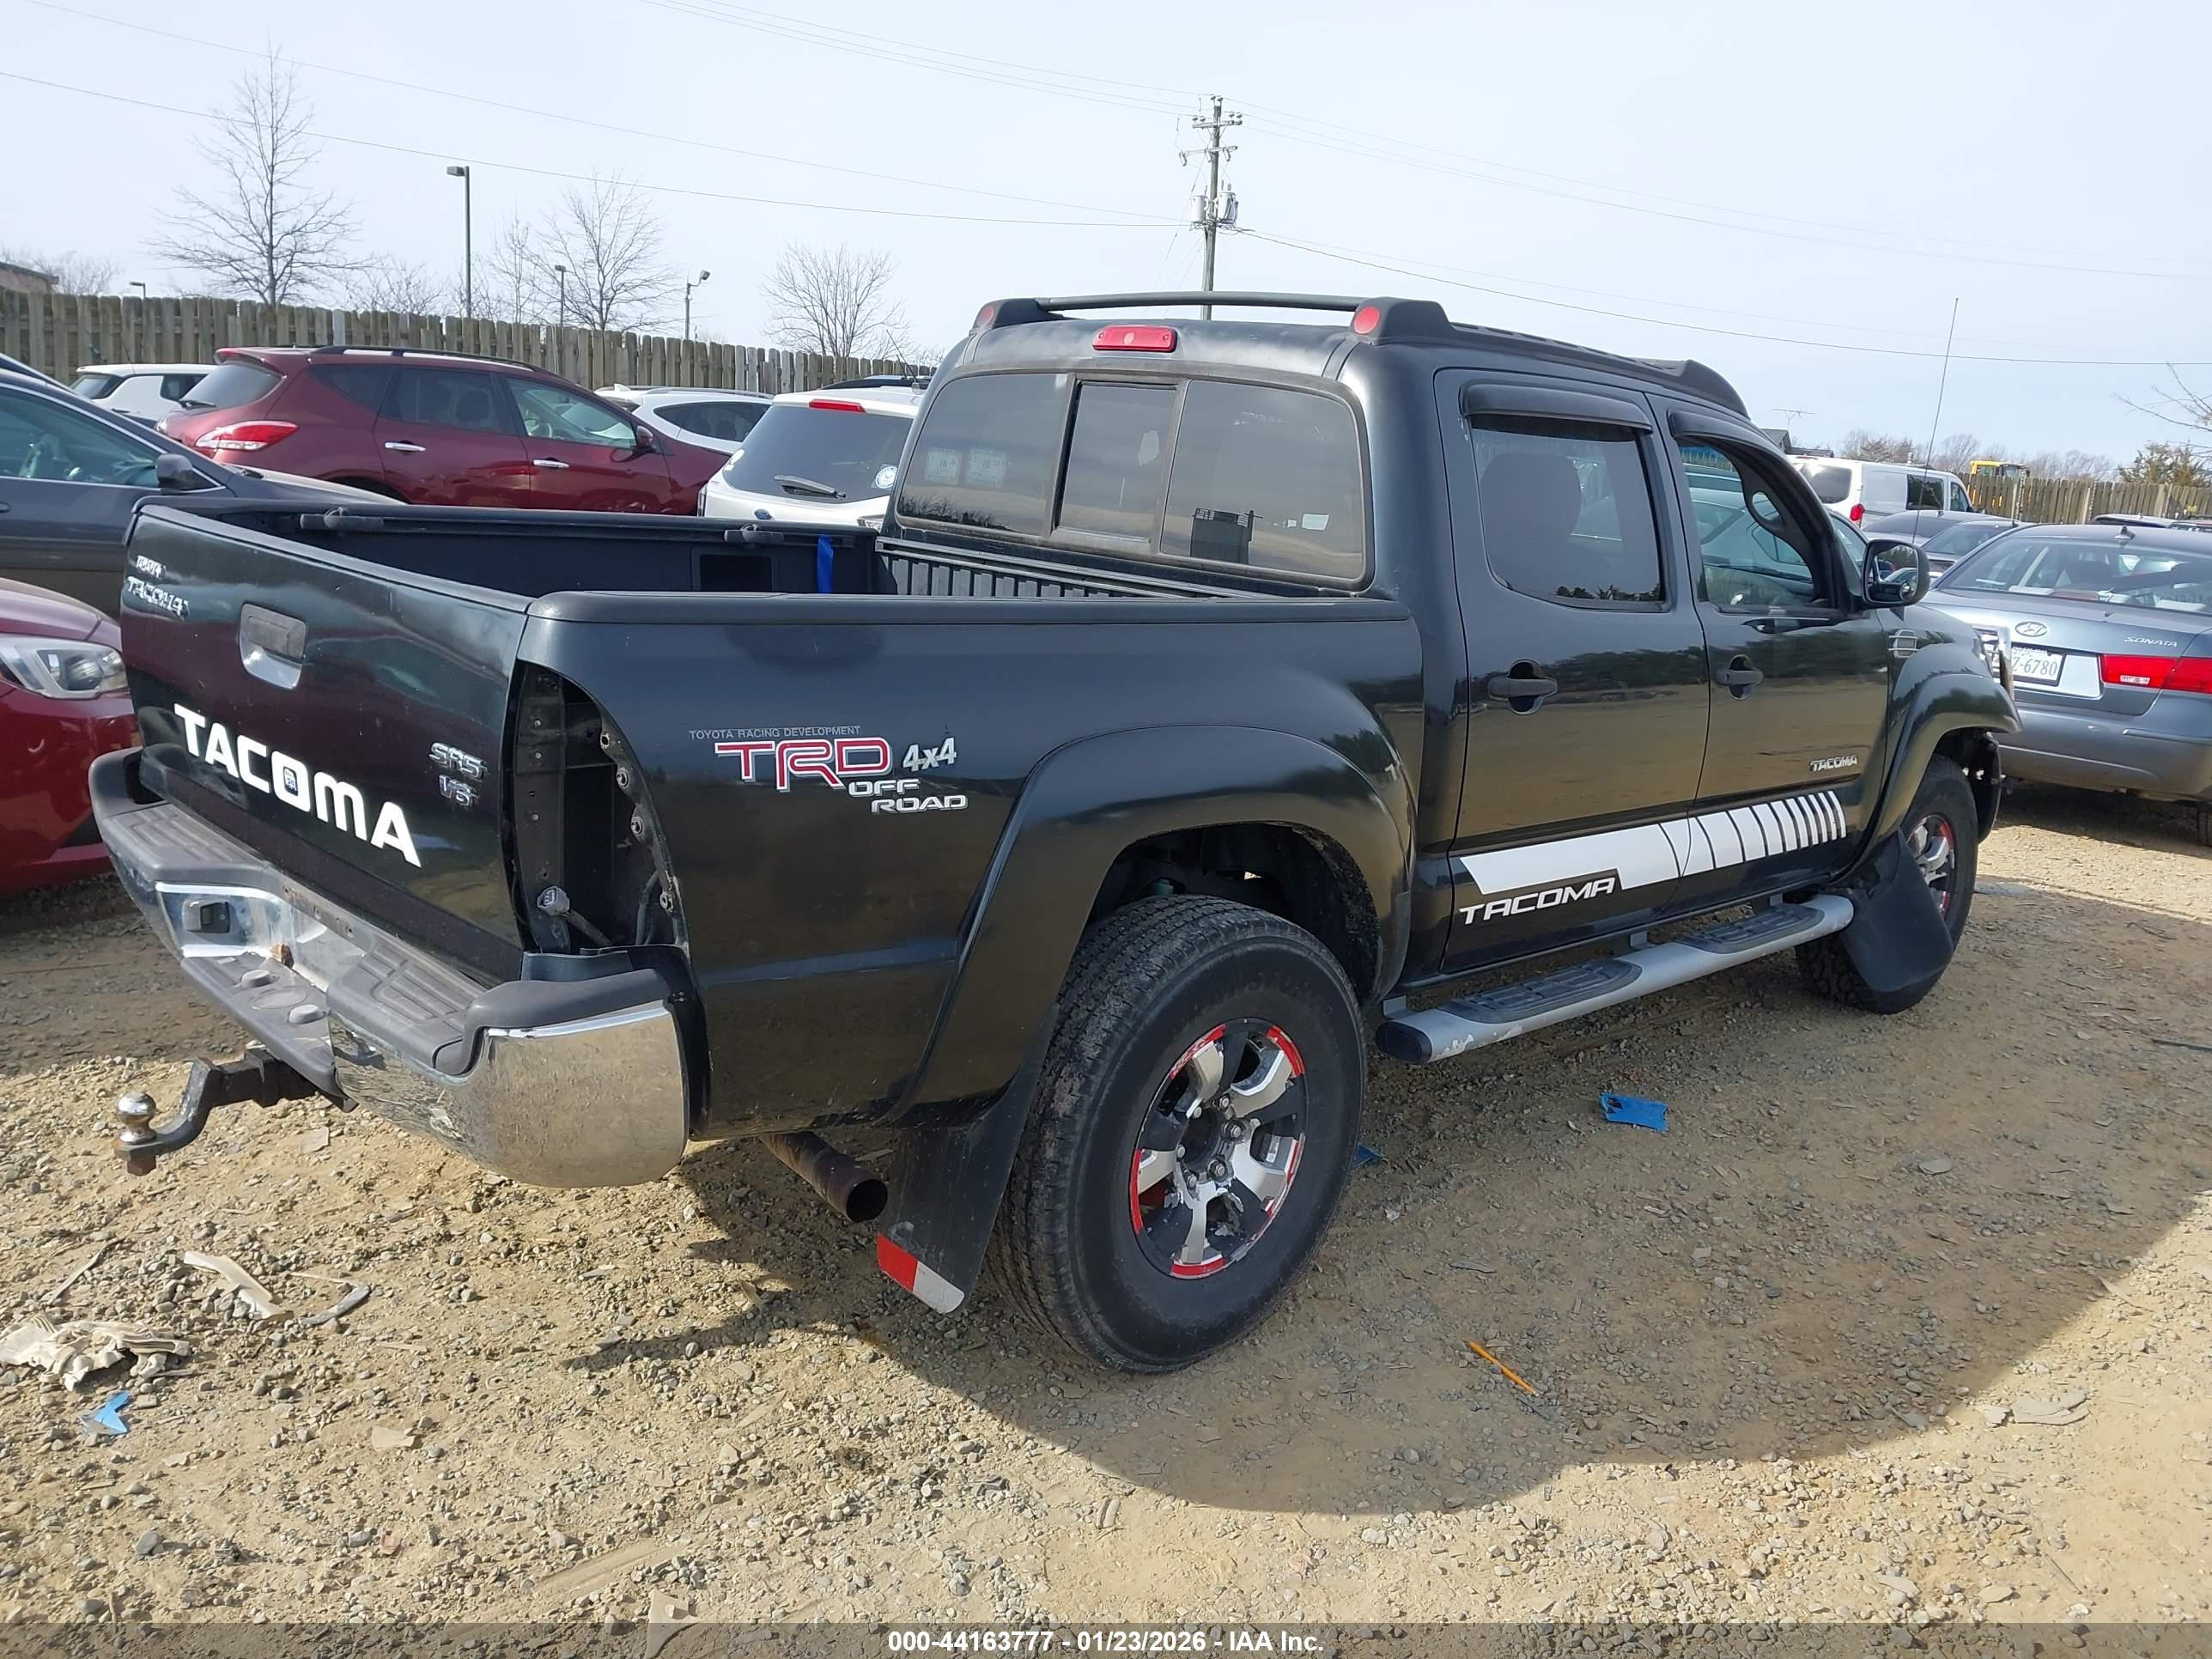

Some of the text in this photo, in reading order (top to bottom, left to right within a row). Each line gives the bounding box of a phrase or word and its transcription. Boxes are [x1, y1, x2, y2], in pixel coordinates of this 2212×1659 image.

[127, 576, 189, 617] TACOMA
[2124, 636, 2178, 647] SONATA
[690, 726, 860, 740] TOYOTA RACING DEVELOPMENT
[714, 737, 957, 792] TRD 4x4
[1810, 756, 1858, 771] TACOMA
[174, 702, 422, 868] TACOMA
[439, 775, 478, 806] V6
[848, 778, 921, 797] OFF
[871, 794, 968, 814] ROAD
[1459, 877, 1616, 925] TACOMA
